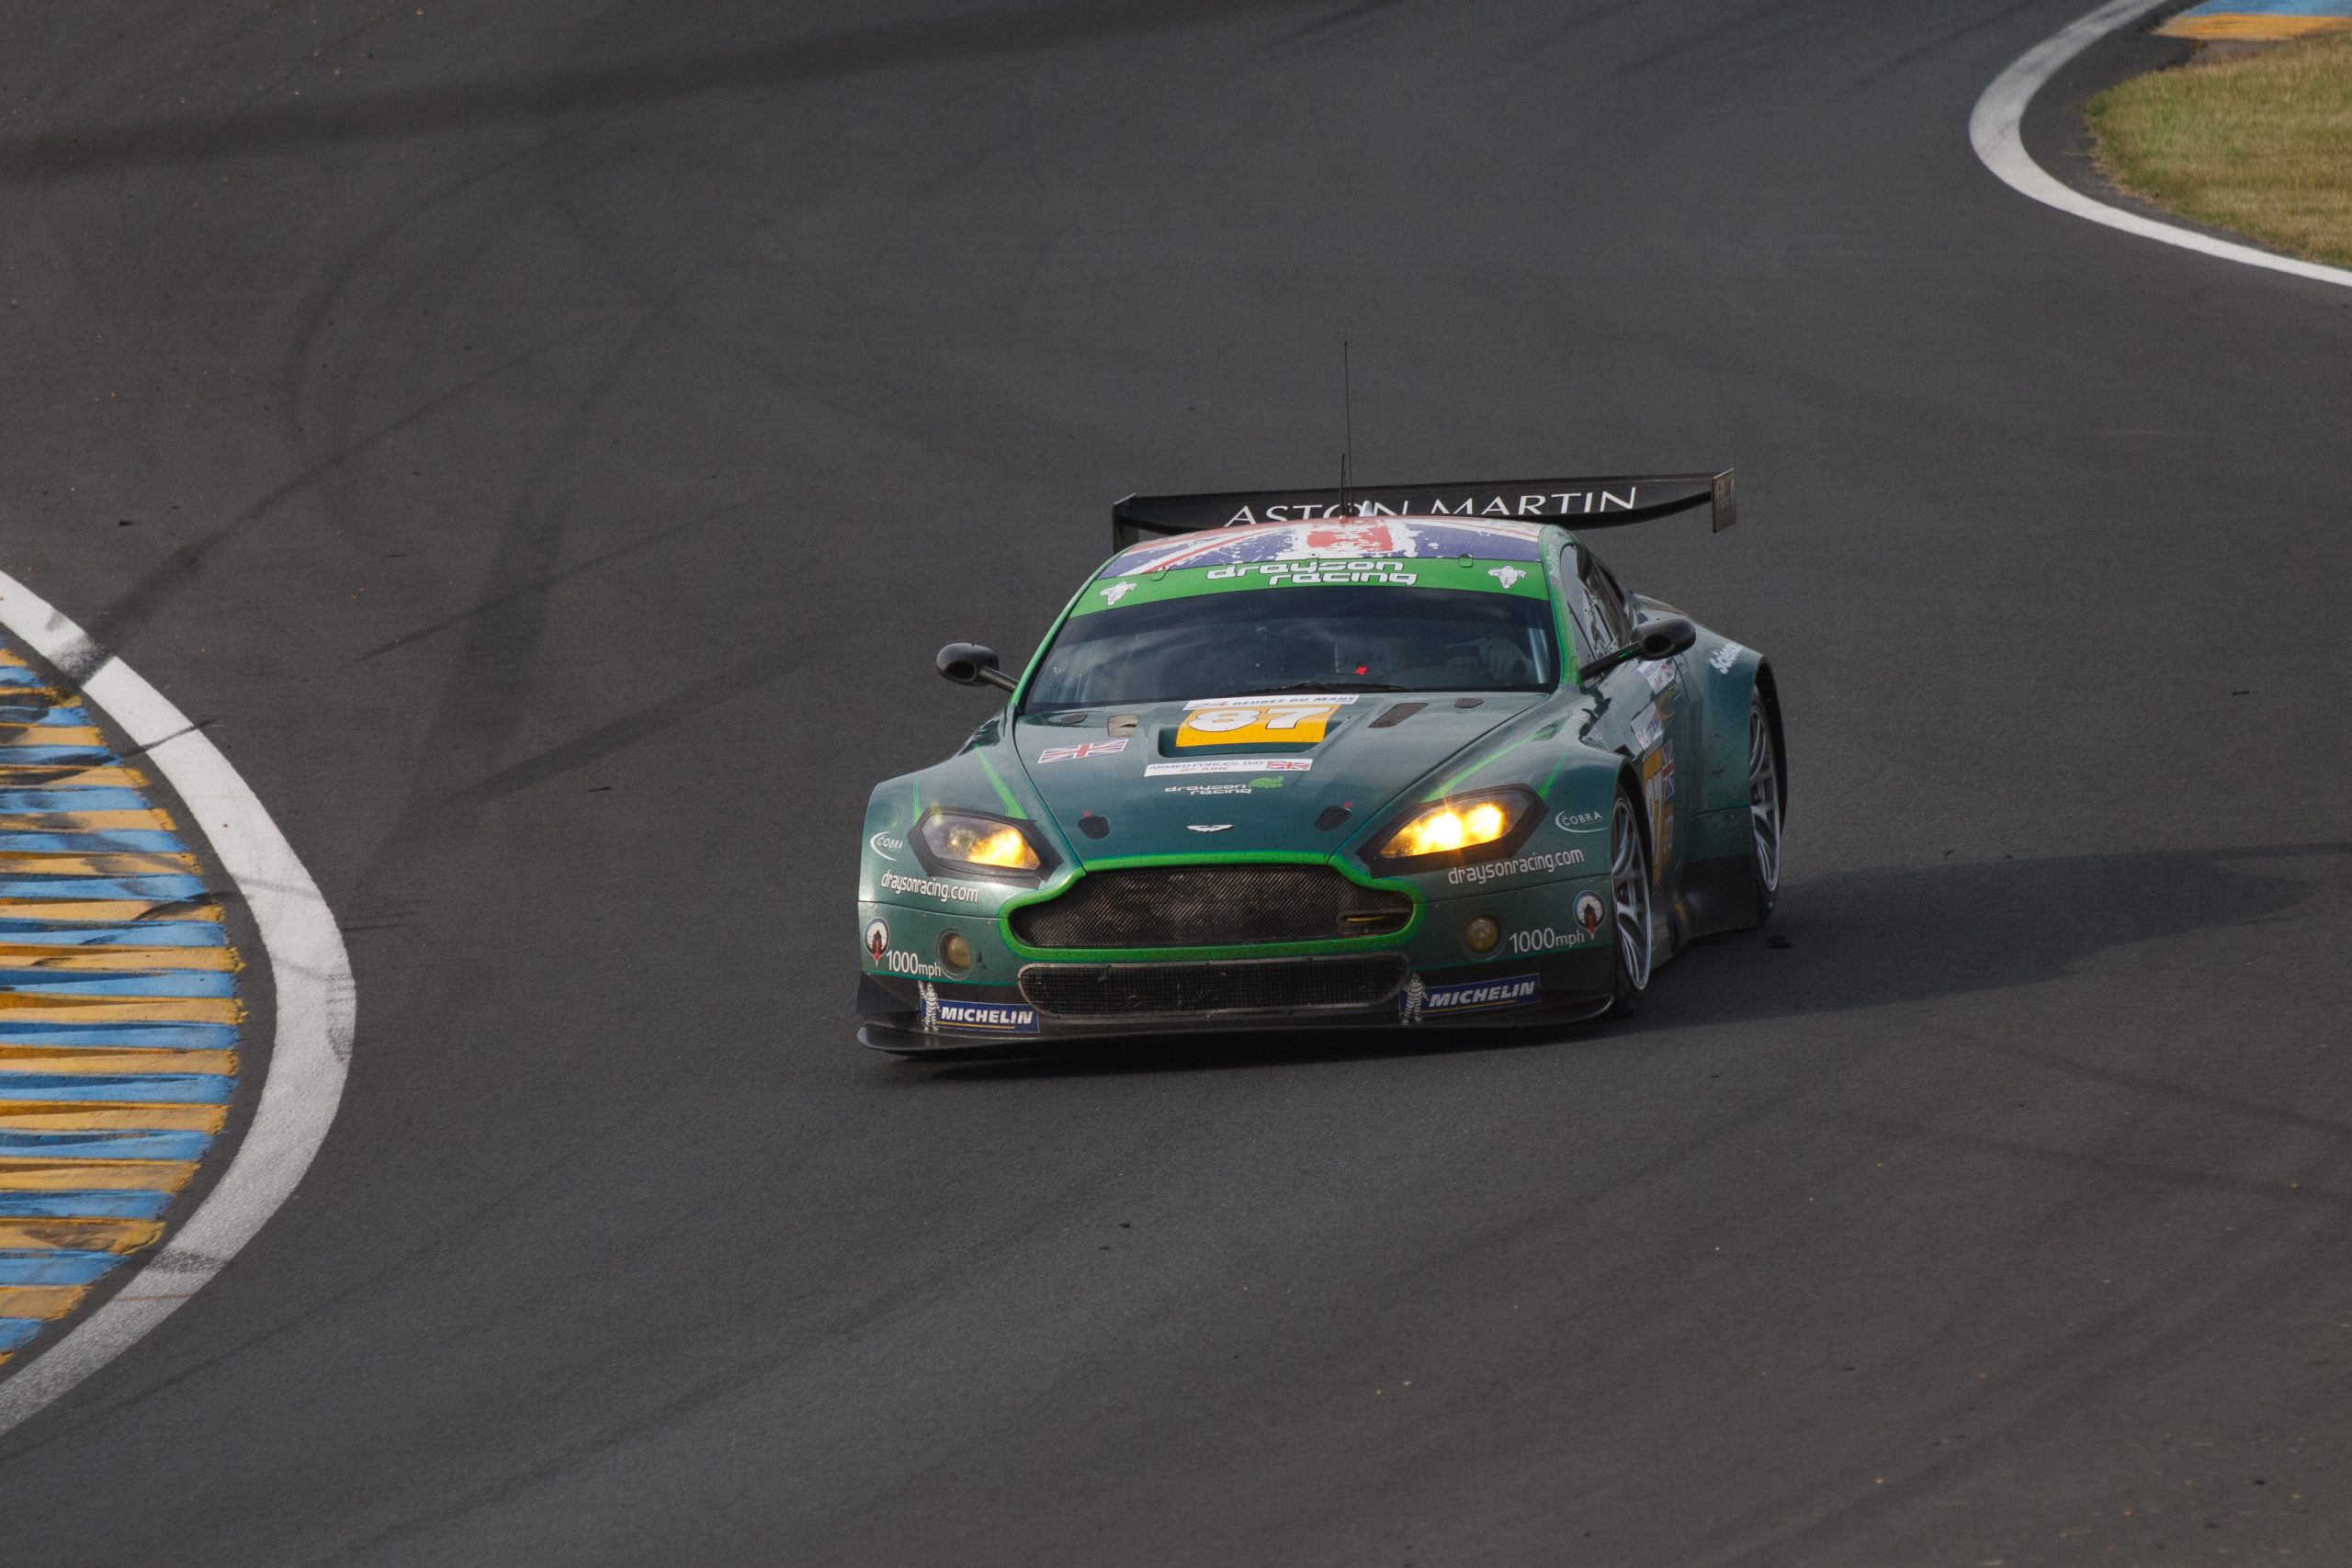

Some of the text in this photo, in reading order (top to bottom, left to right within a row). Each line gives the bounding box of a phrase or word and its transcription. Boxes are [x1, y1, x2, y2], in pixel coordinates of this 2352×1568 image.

[1430, 486, 1636, 515] MARTIN
[1205, 560, 1405, 580] drayson
[1267, 571, 1419, 586] racing
[1187, 706, 1334, 733] 87
[1164, 784, 1247, 793] drayson
[1562, 811, 1603, 826] COBRA
[876, 834, 903, 850] COBRA
[1448, 848, 1585, 885] draysonracing.com
[881, 869, 978, 903] draysonracing.com
[1509, 927, 1585, 953] 1000mph
[886, 950, 942, 979] 1000mph
[1429, 980, 1536, 1008] MICHELIN
[940, 1005, 1034, 1025] MICHELIN
